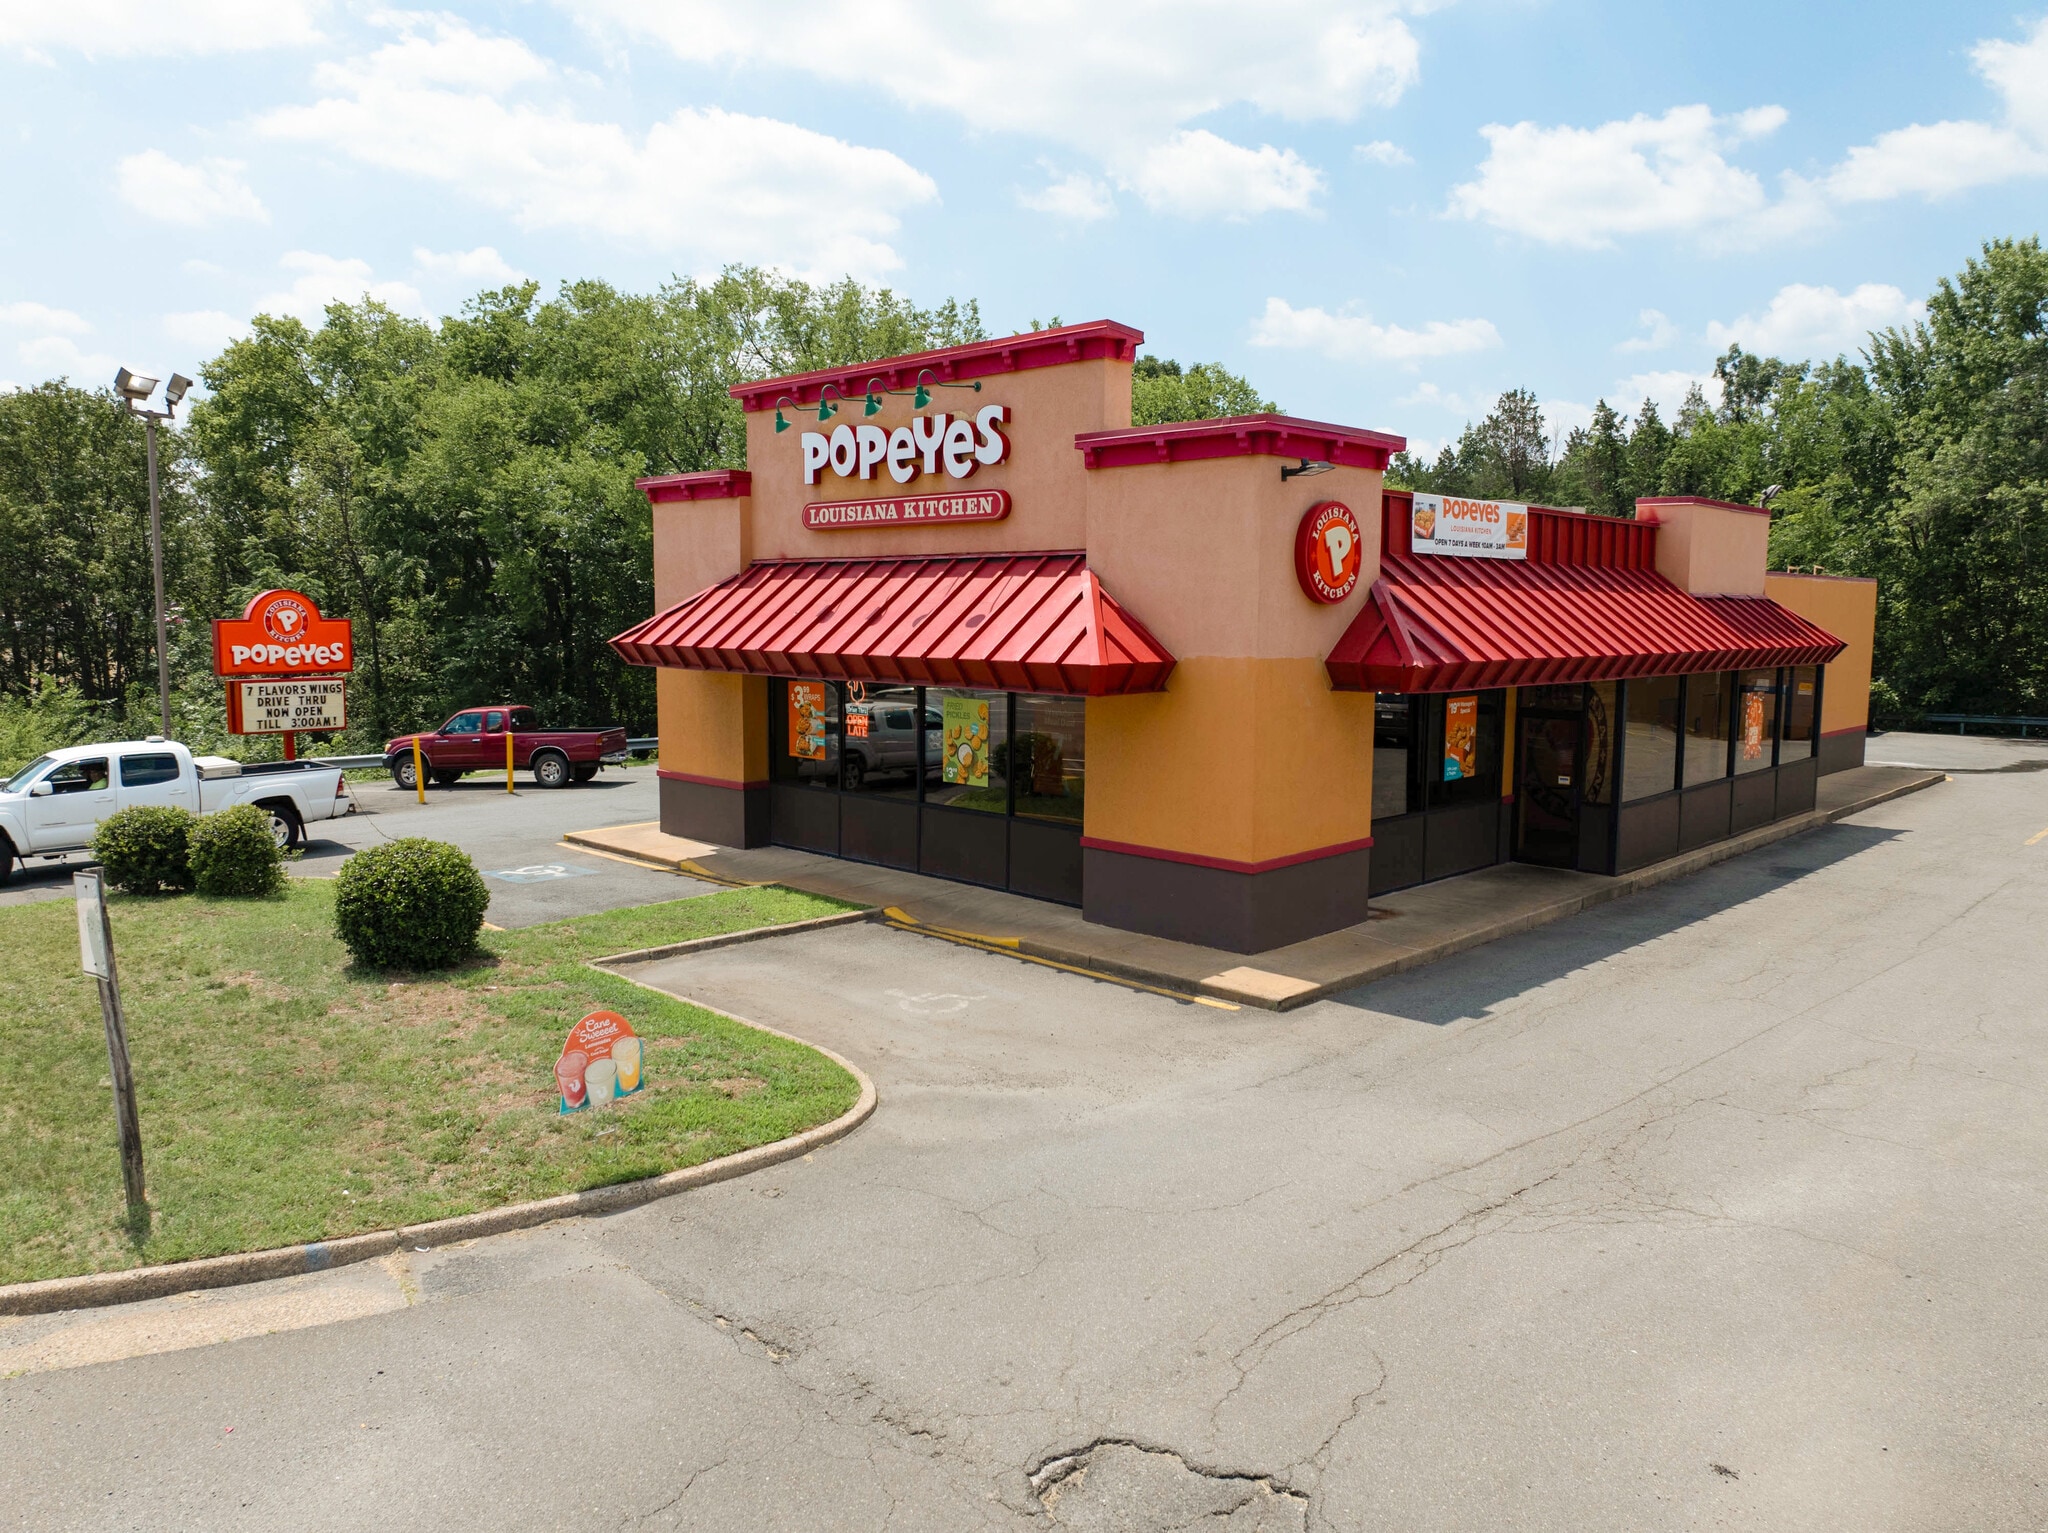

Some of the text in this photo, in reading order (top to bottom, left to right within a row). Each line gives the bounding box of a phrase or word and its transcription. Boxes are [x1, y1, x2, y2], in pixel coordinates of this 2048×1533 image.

[809, 497, 993, 524] LOUISIANA KITCHEN
[1312, 507, 1359, 544] LOUISIANA
[1450, 525, 1492, 535] LOUISIANA KITCHEN
[1434, 538, 1447, 547] OPEN
[1325, 526, 1352, 577] P
[1313, 570, 1356, 599] KITCHEN
[266, 600, 307, 617] LOUISIANA
[276, 609, 298, 632] P
[269, 629, 306, 643] KITCHEN
[247, 683, 342, 696] 7 FLAVORS WINGS
[257, 695, 327, 707] DRIVE THRU
[946, 702, 963, 710] FRIED
[266, 706, 323, 718] NOW OPEN
[946, 711, 971, 720] PICKLES
[256, 720, 281, 730] TILL
[846, 714, 868, 726] OPEN
[847, 725, 868, 737] LATE
[585, 1019, 610, 1032] Cane
